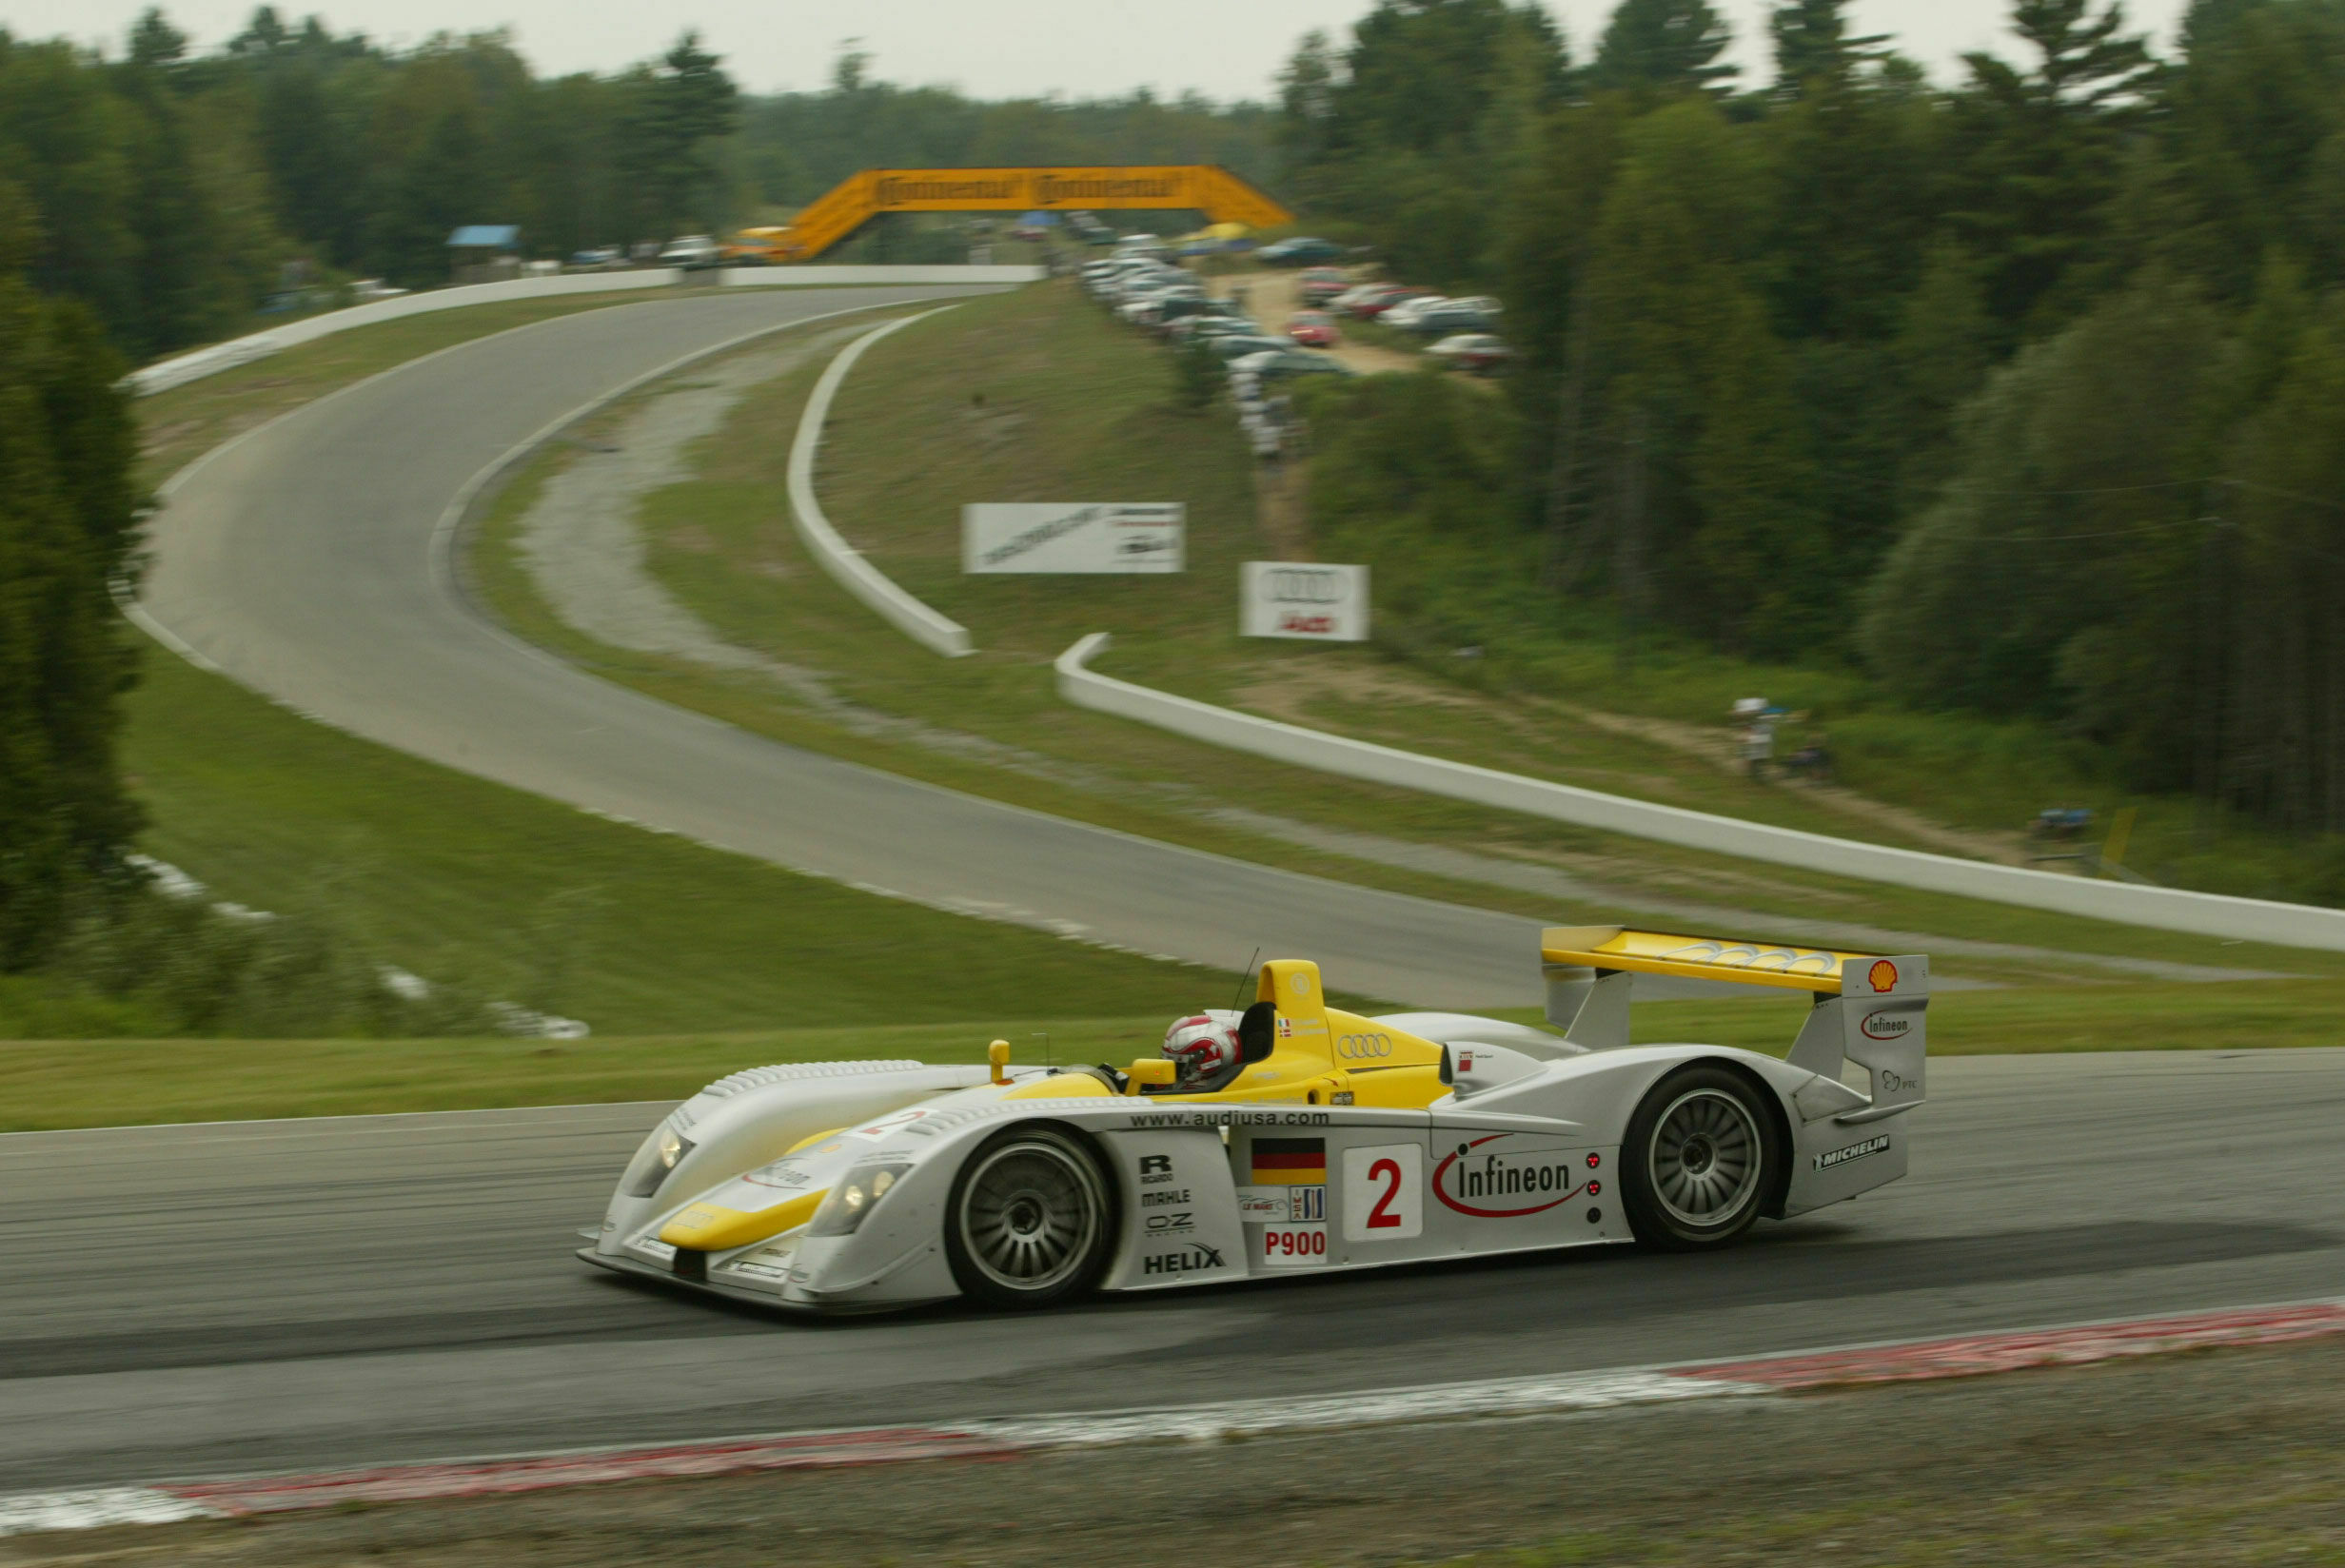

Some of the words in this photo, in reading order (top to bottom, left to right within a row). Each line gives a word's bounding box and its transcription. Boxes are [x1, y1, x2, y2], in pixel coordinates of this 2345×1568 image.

[1869, 1012, 1908, 1033] Infineon
[1130, 1109, 1330, 1127] www.audiusa.com
[1823, 1134, 1890, 1166] MICHELIN
[1457, 1143, 1569, 1199] Infineon
[1142, 1188, 1192, 1206] MAHLE
[1366, 1158, 1401, 1228] 2
[1265, 1231, 1326, 1255] P900
[1144, 1243, 1226, 1274] HELIX
